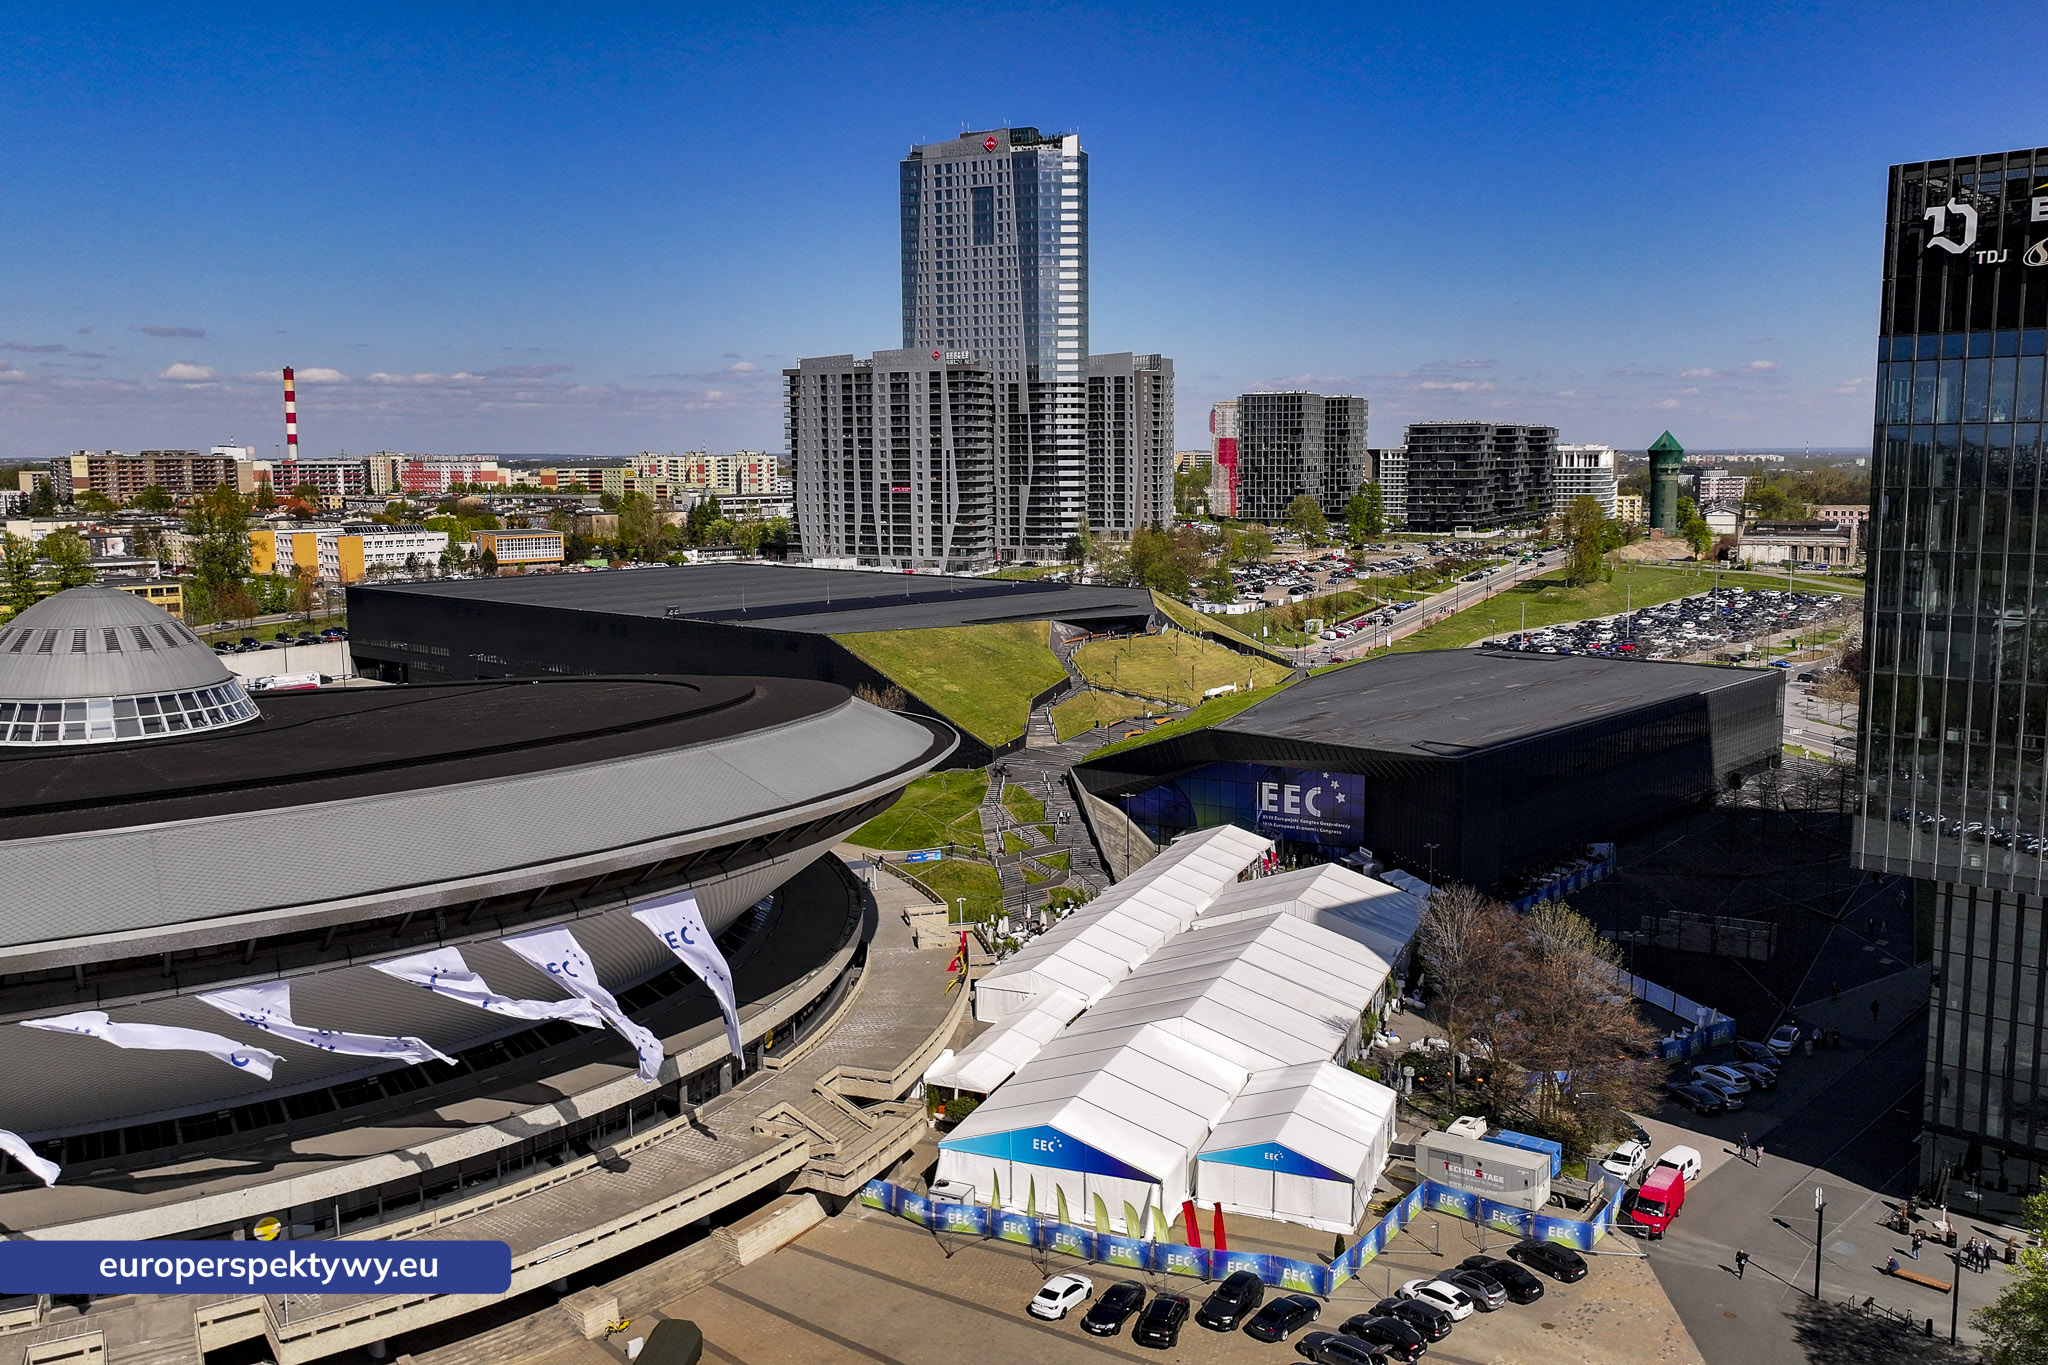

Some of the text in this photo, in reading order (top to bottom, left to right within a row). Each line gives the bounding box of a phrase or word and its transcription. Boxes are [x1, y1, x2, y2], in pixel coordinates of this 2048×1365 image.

[1976, 249, 2008, 264] TDJ
[1262, 782, 1321, 817] EEC
[1320, 821, 1351, 829] Gospodarczy
[1033, 1138, 1054, 1152] EEC
[1264, 1152, 1279, 1161] EEC
[904, 1199, 920, 1214] EEC
[1440, 1193, 1460, 1208] EEC
[948, 1213, 970, 1225] EEC
[1493, 1209, 1513, 1224] EEC
[1003, 1221, 1023, 1234] EEC
[1548, 1226, 1571, 1240] EEC
[1055, 1232, 1076, 1246] EEC
[1110, 1245, 1132, 1258] EEC
[1167, 1254, 1191, 1266] EEC
[1283, 1268, 1306, 1282] EEC
